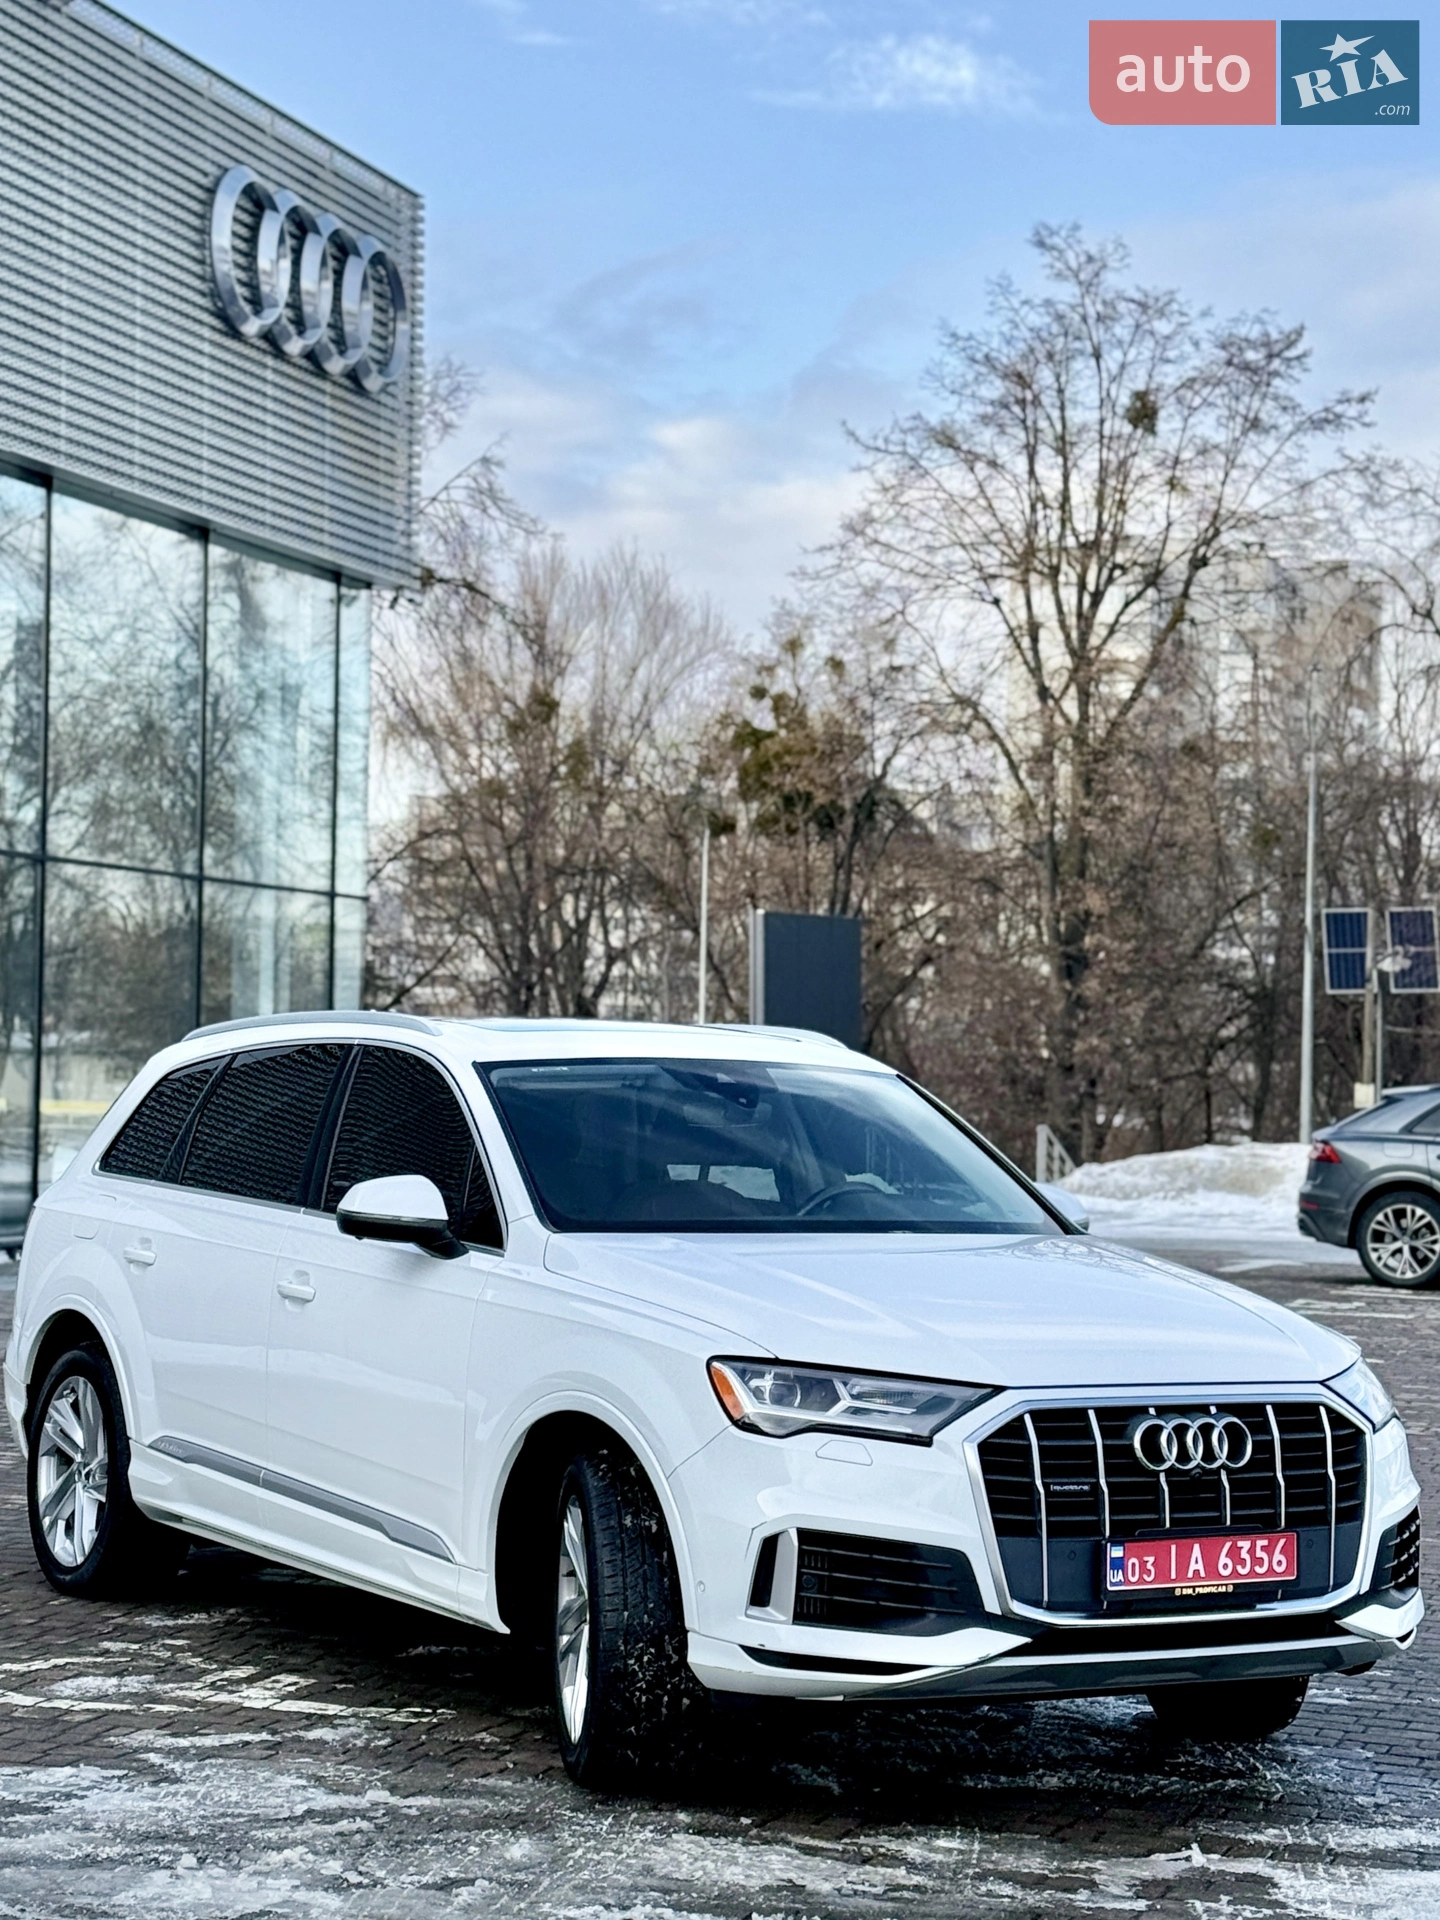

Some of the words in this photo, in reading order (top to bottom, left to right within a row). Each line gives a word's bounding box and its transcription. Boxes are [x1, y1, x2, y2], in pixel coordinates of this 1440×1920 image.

[1127, 1556, 1156, 1583] 03
[1217, 1538, 1288, 1577] 6356
[1110, 1569, 1124, 1583] UA
